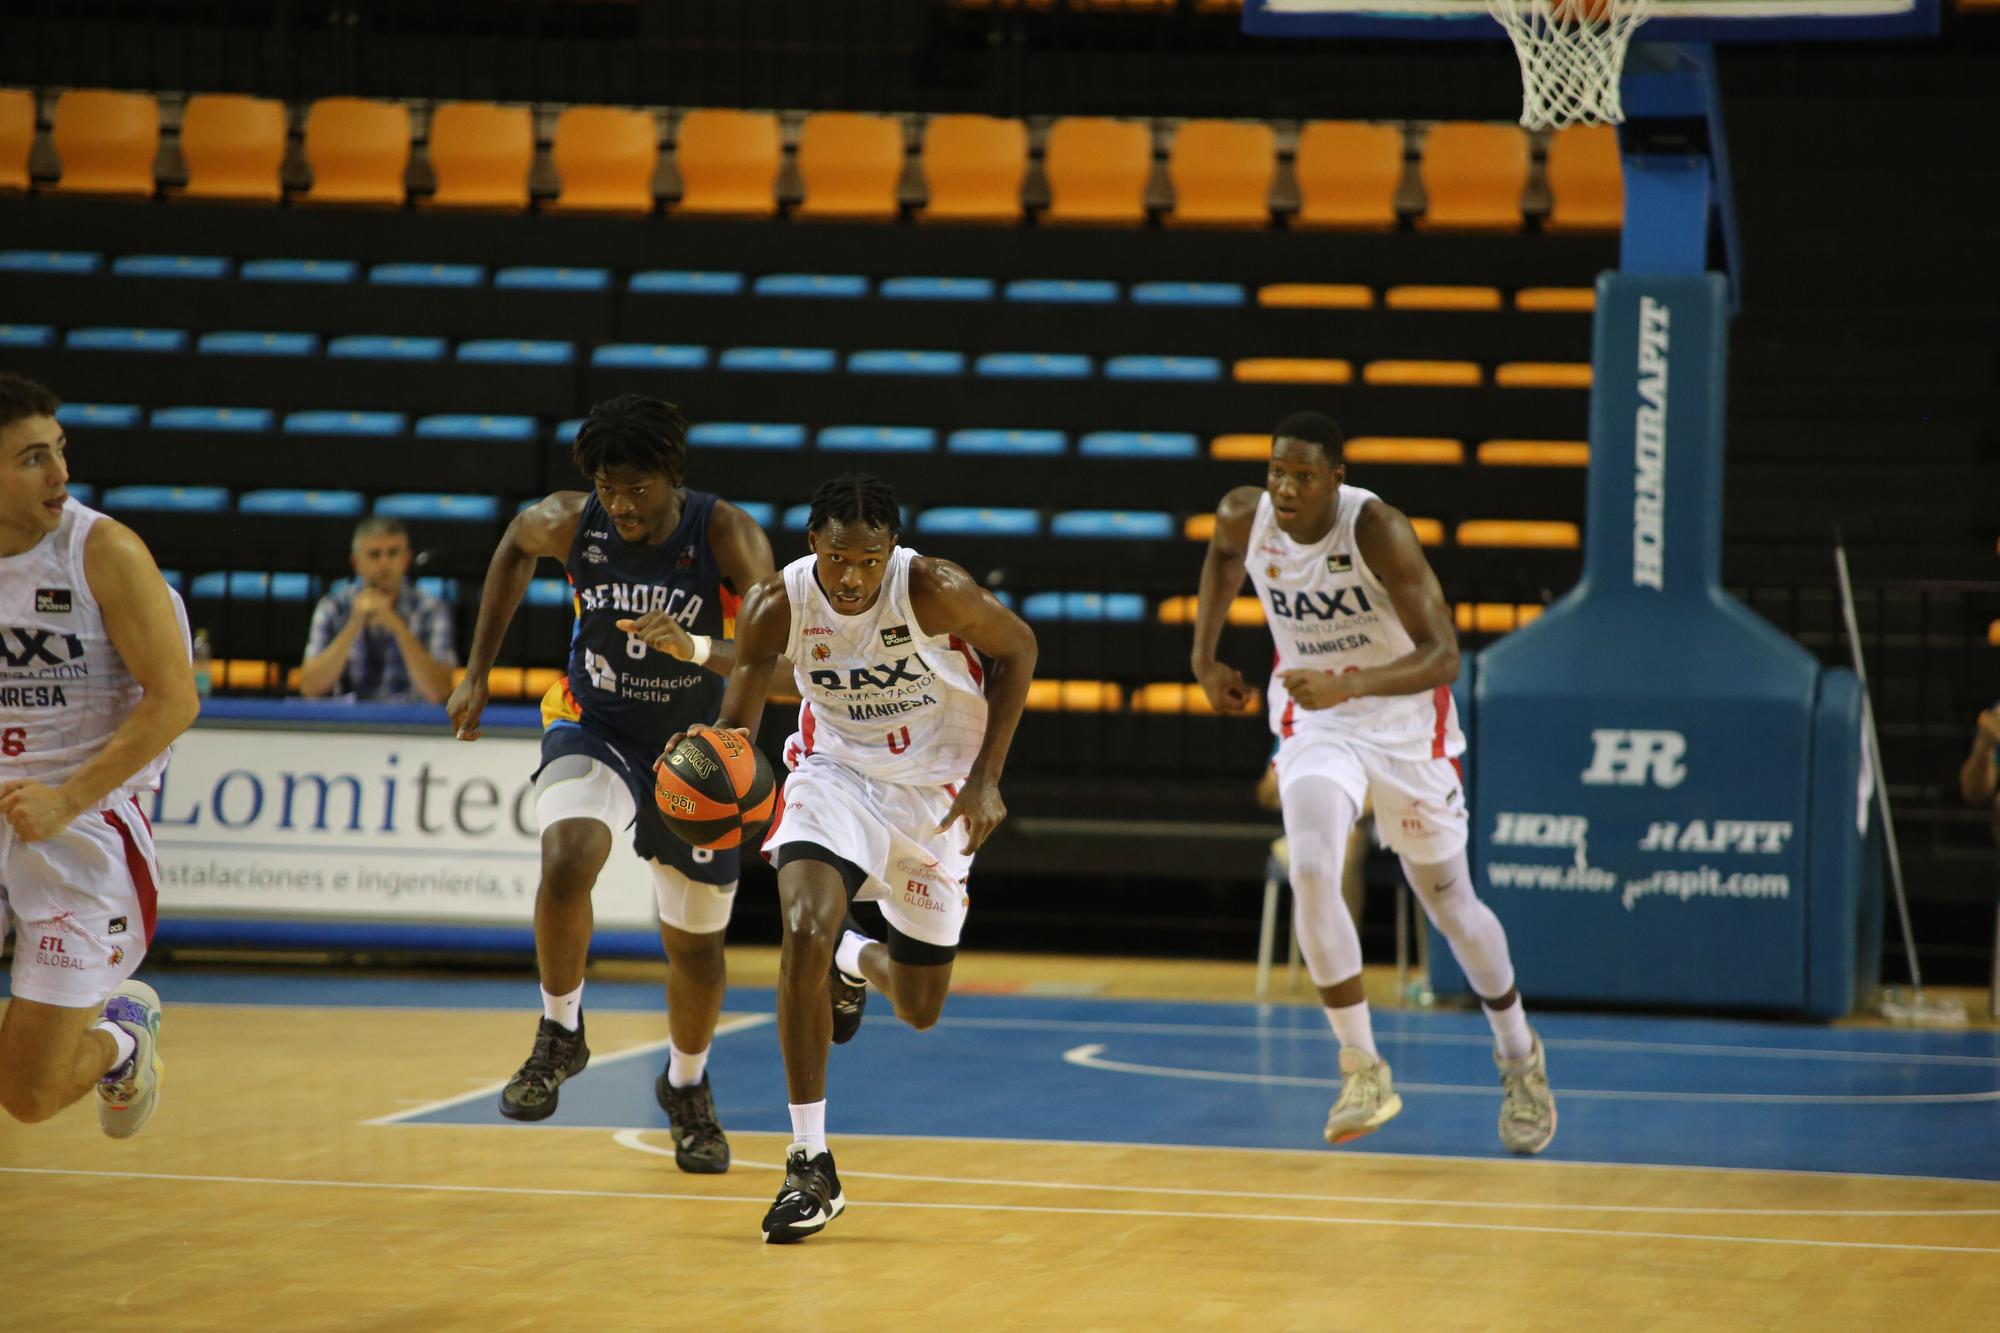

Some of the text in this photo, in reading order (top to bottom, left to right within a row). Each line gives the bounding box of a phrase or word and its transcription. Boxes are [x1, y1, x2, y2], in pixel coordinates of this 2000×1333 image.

[1268, 586, 1373, 621] BAXI
[1295, 633, 1372, 656] MANRESA
[621, 672, 703, 689] Fundación
[622, 687, 671, 703] Hestia
[848, 694, 937, 721] MANRESA
[2, 727, 26, 757] 6
[1581, 728, 1687, 789] HR
[332, 872, 349, 891] e
[905, 879, 930, 897] ETL
[903, 893, 946, 913] GLOBAL
[39, 935, 65, 953] ETL
[35, 952, 85, 971] GLOBAL
